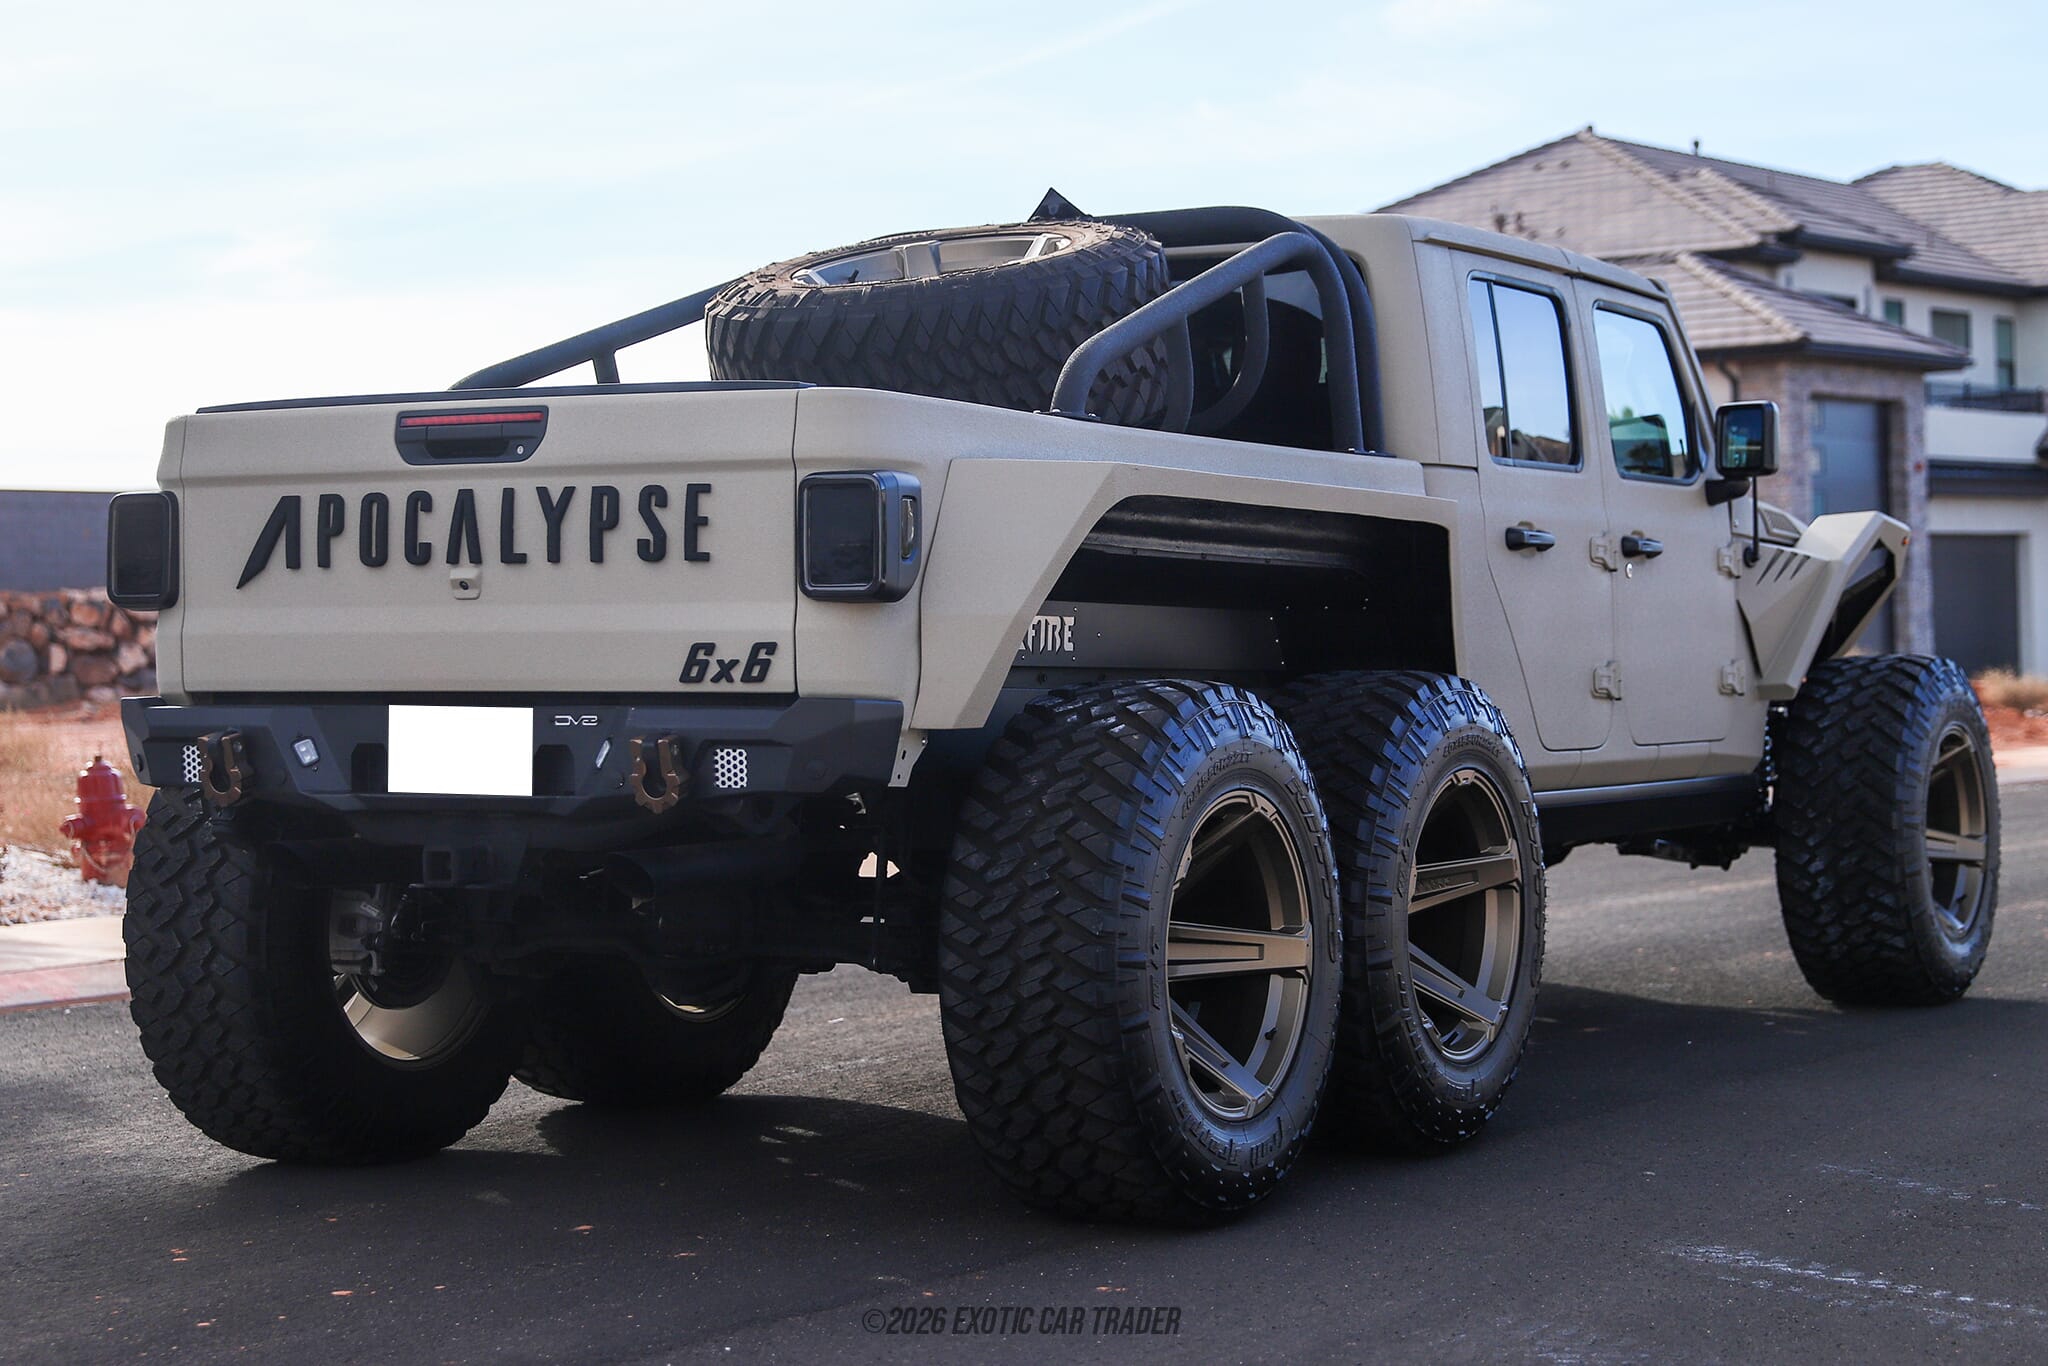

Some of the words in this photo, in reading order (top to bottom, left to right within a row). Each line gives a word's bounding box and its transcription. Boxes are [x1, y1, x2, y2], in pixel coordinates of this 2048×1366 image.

[236, 483, 712, 590] APOCALYPSE
[1018, 615, 1075, 653] FIRE
[679, 641, 778, 684] 6x6
